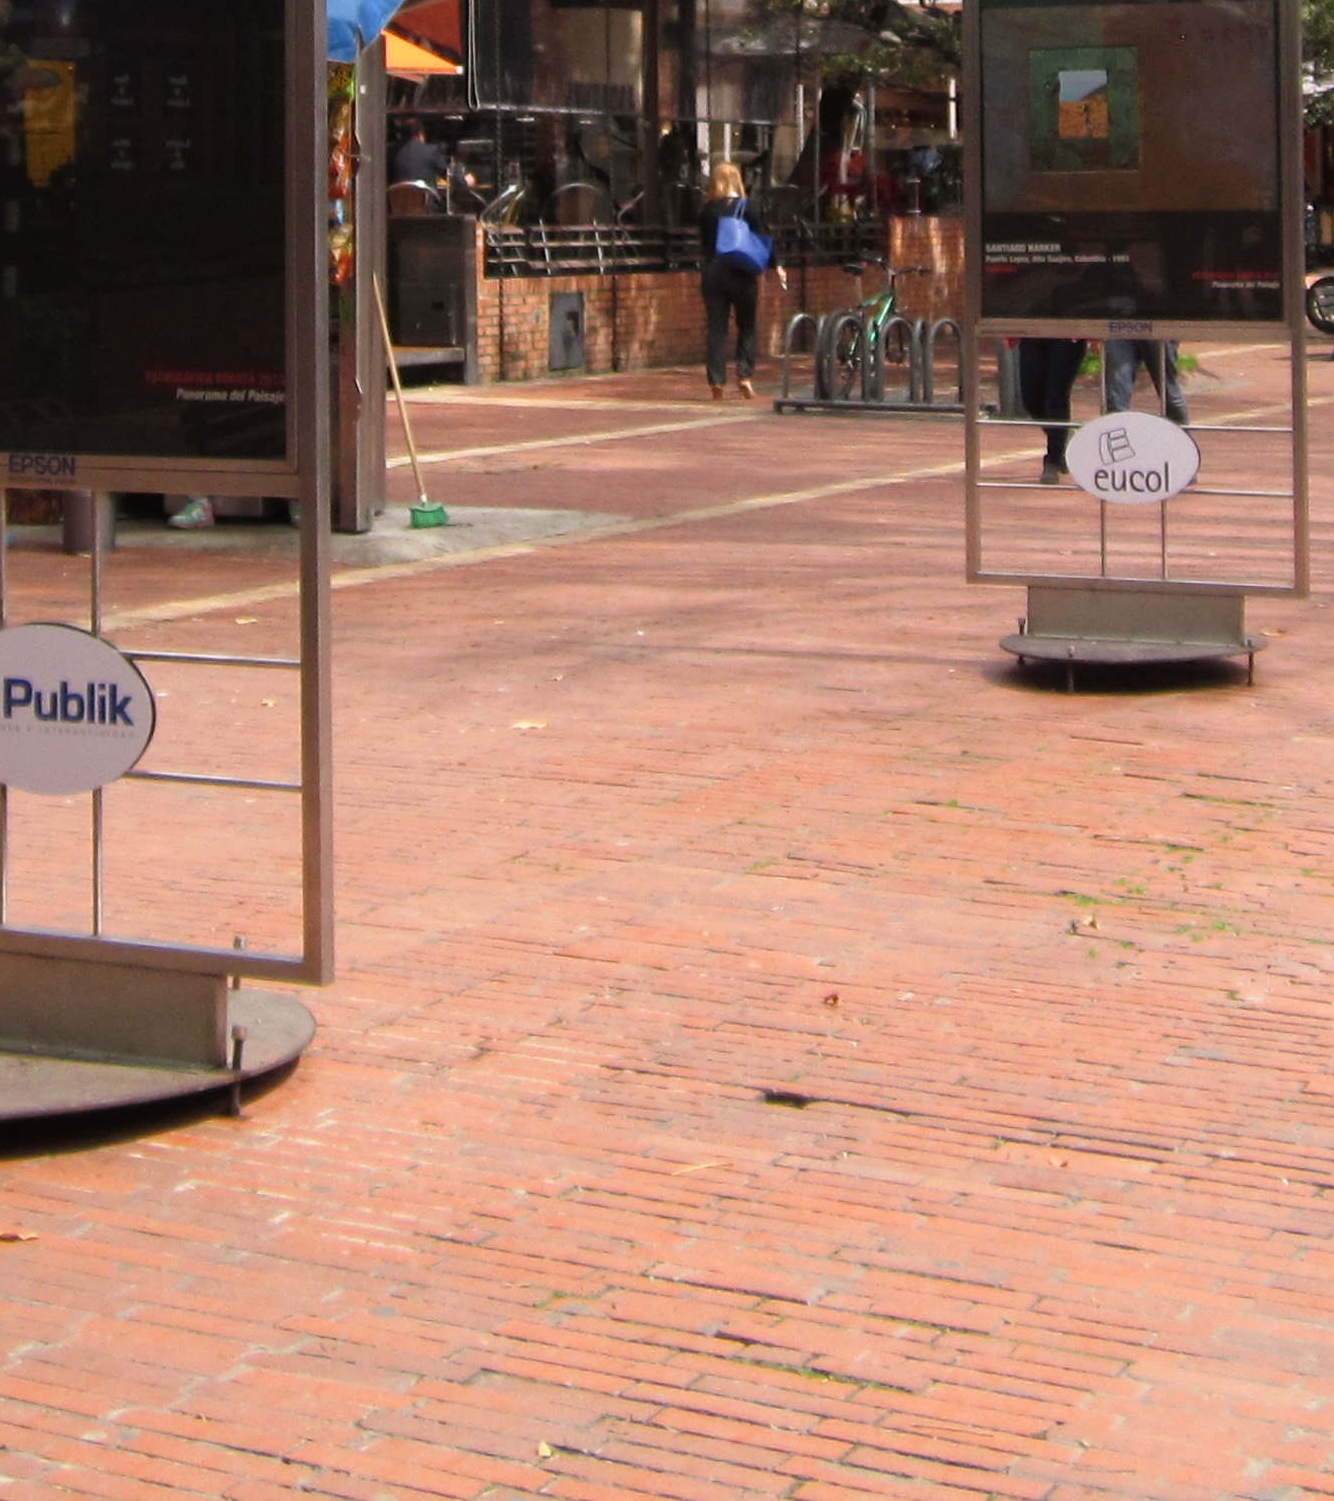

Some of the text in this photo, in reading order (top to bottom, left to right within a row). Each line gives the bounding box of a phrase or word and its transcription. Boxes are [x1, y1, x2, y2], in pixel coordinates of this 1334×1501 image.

[229, 389, 245, 402] del
[8, 454, 76, 476] EPSON
[1094, 461, 1170, 493] eucol
[3, 678, 135, 727] Publik
